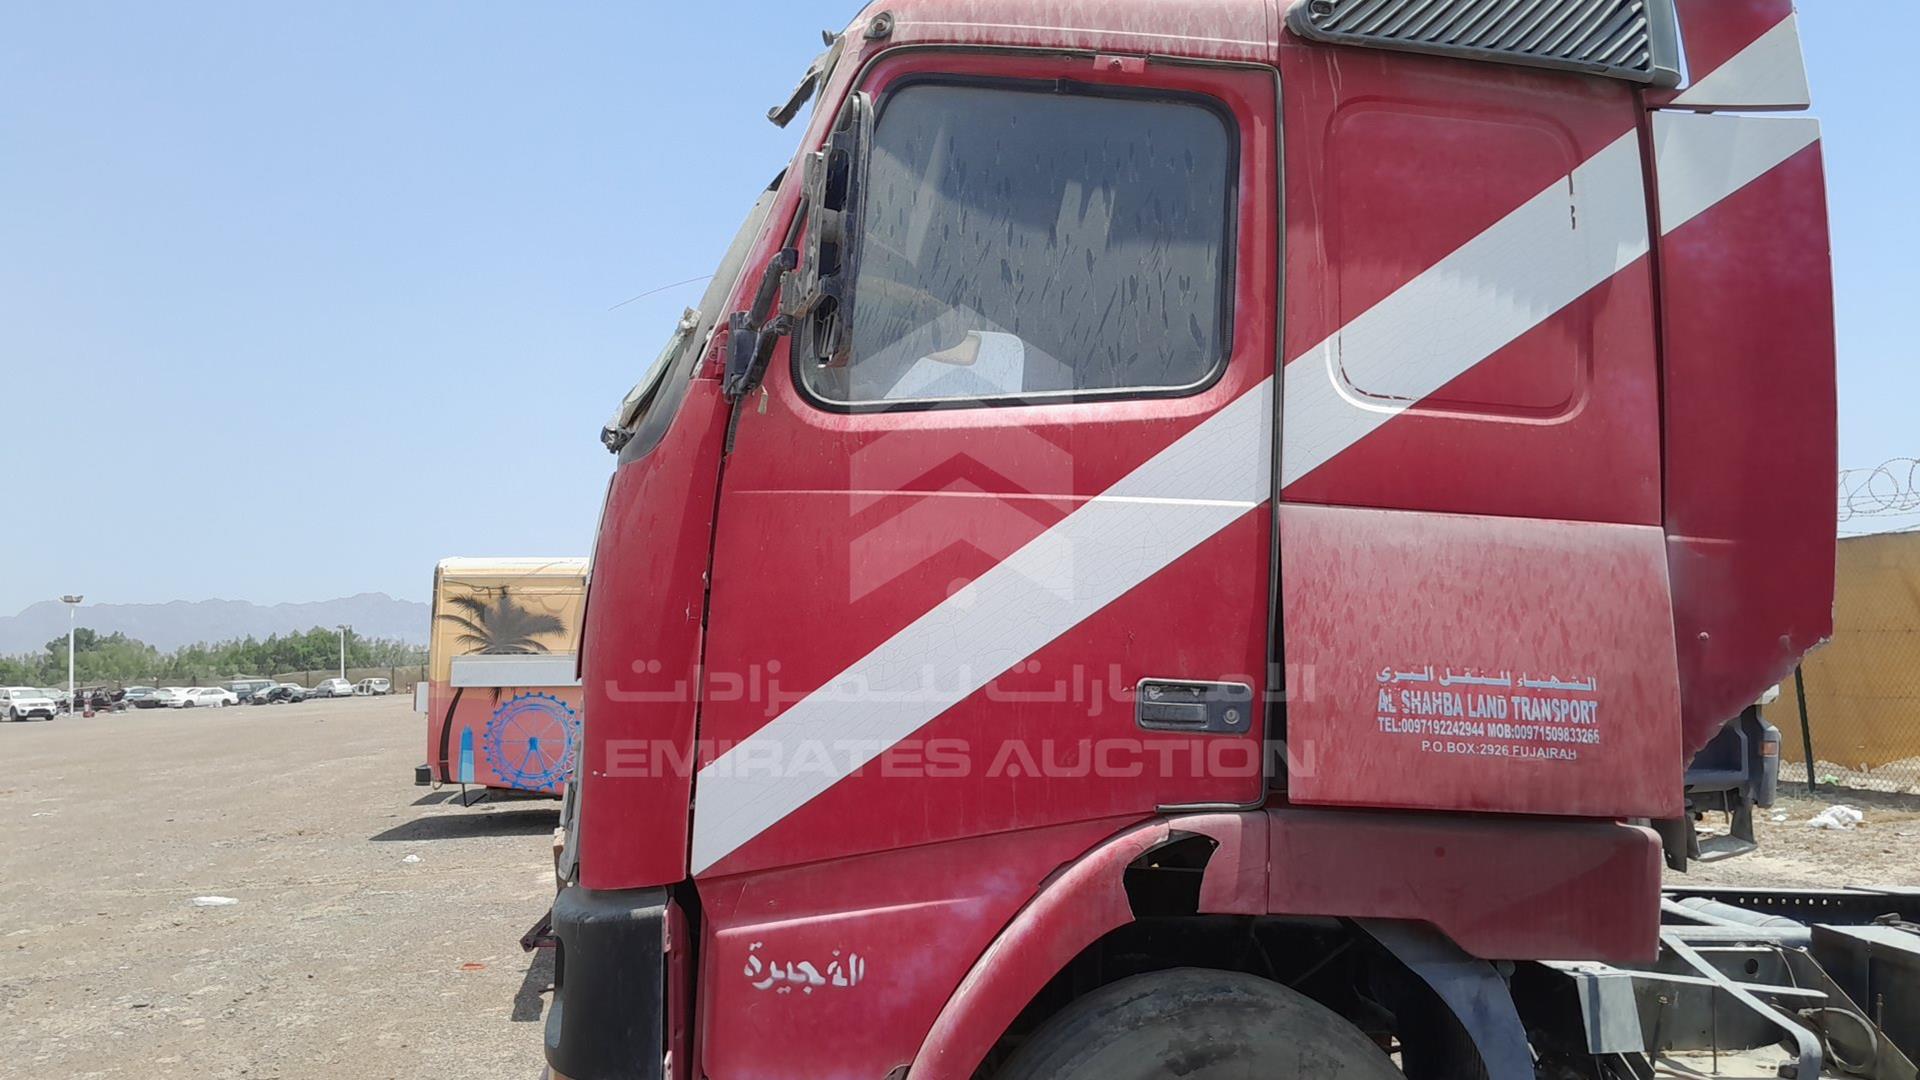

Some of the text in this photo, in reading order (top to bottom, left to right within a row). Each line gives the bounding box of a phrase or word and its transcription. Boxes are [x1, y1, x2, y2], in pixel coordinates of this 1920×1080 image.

[1438, 666, 1511, 687] للنقل
[1516, 672, 1597, 692] الشهباء
[1377, 688, 1598, 724] AL SHAHBA LAND TRANSPORT
[1377, 717, 1485, 737] TEL:0097192242944
[1512, 745, 1577, 760] FUJAIRAH
[743, 940, 865, 995] الفجيرة
